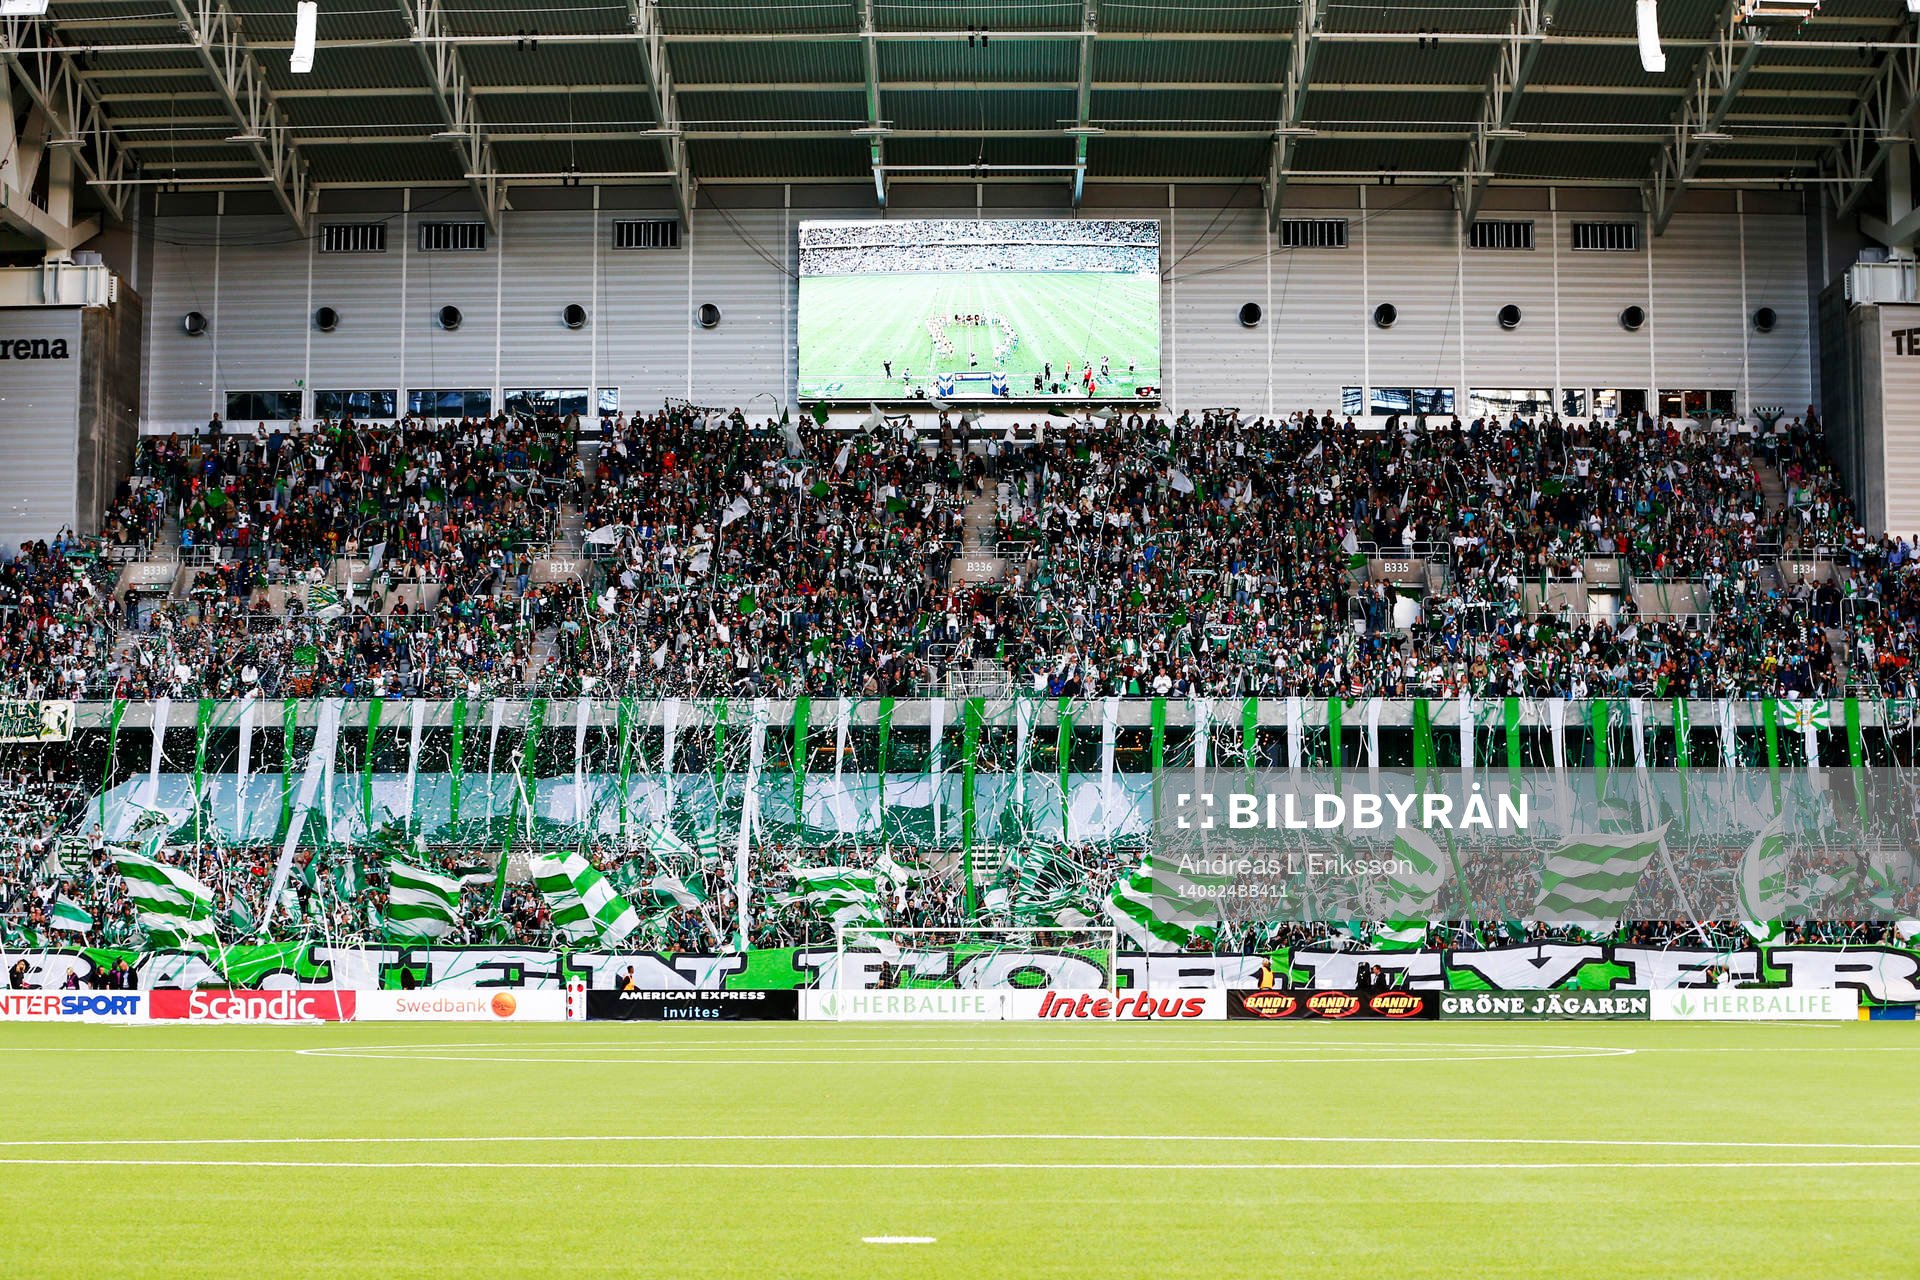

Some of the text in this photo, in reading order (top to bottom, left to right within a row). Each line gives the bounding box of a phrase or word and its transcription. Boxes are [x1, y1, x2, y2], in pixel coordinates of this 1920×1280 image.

[0, 338, 69, 360] rena
[143, 565, 168, 575] B338
[967, 562, 992, 572] B336
[1384, 562, 1409, 573] B335
[1792, 564, 1816, 574] B334
[619, 991, 766, 1000] AMERICAN EXPRESS
[189, 991, 316, 1019] Scandic
[396, 997, 487, 1013] Swedbank
[853, 995, 987, 1014] HERBALIFE
[1038, 990, 1206, 1018] Interbus
[1246, 996, 1296, 1008] BANDIT
[1309, 996, 1359, 1008] BANDIT
[1372, 996, 1422, 1008] BANDIT
[1441, 993, 1648, 1014] GRÖNE JÄGAREN
[1703, 995, 1832, 1013] HERBALIFE
[663, 1006, 720, 1018] invites
